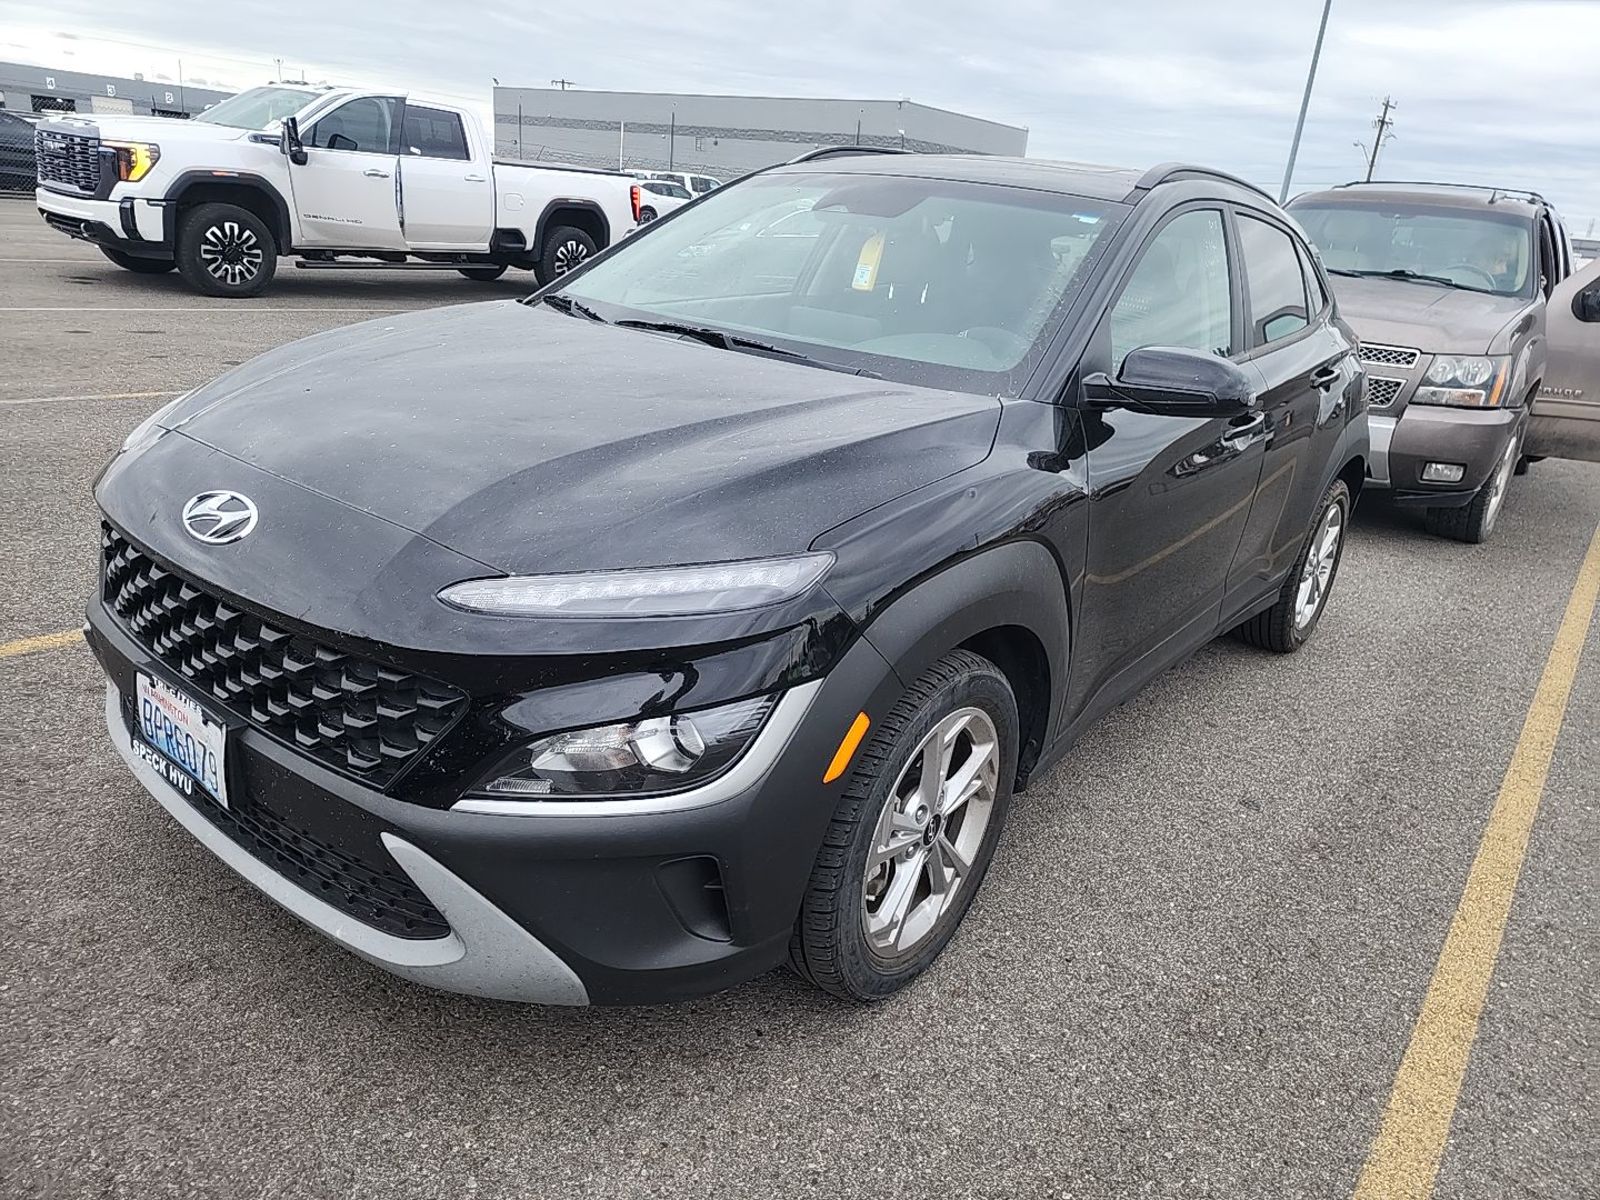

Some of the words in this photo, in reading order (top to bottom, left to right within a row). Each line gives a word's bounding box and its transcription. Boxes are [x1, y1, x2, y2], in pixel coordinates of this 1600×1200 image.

[132, 739, 168, 778] SPECK
[169, 764, 193, 796] HYU
[143, 697, 219, 793] BPR6079
